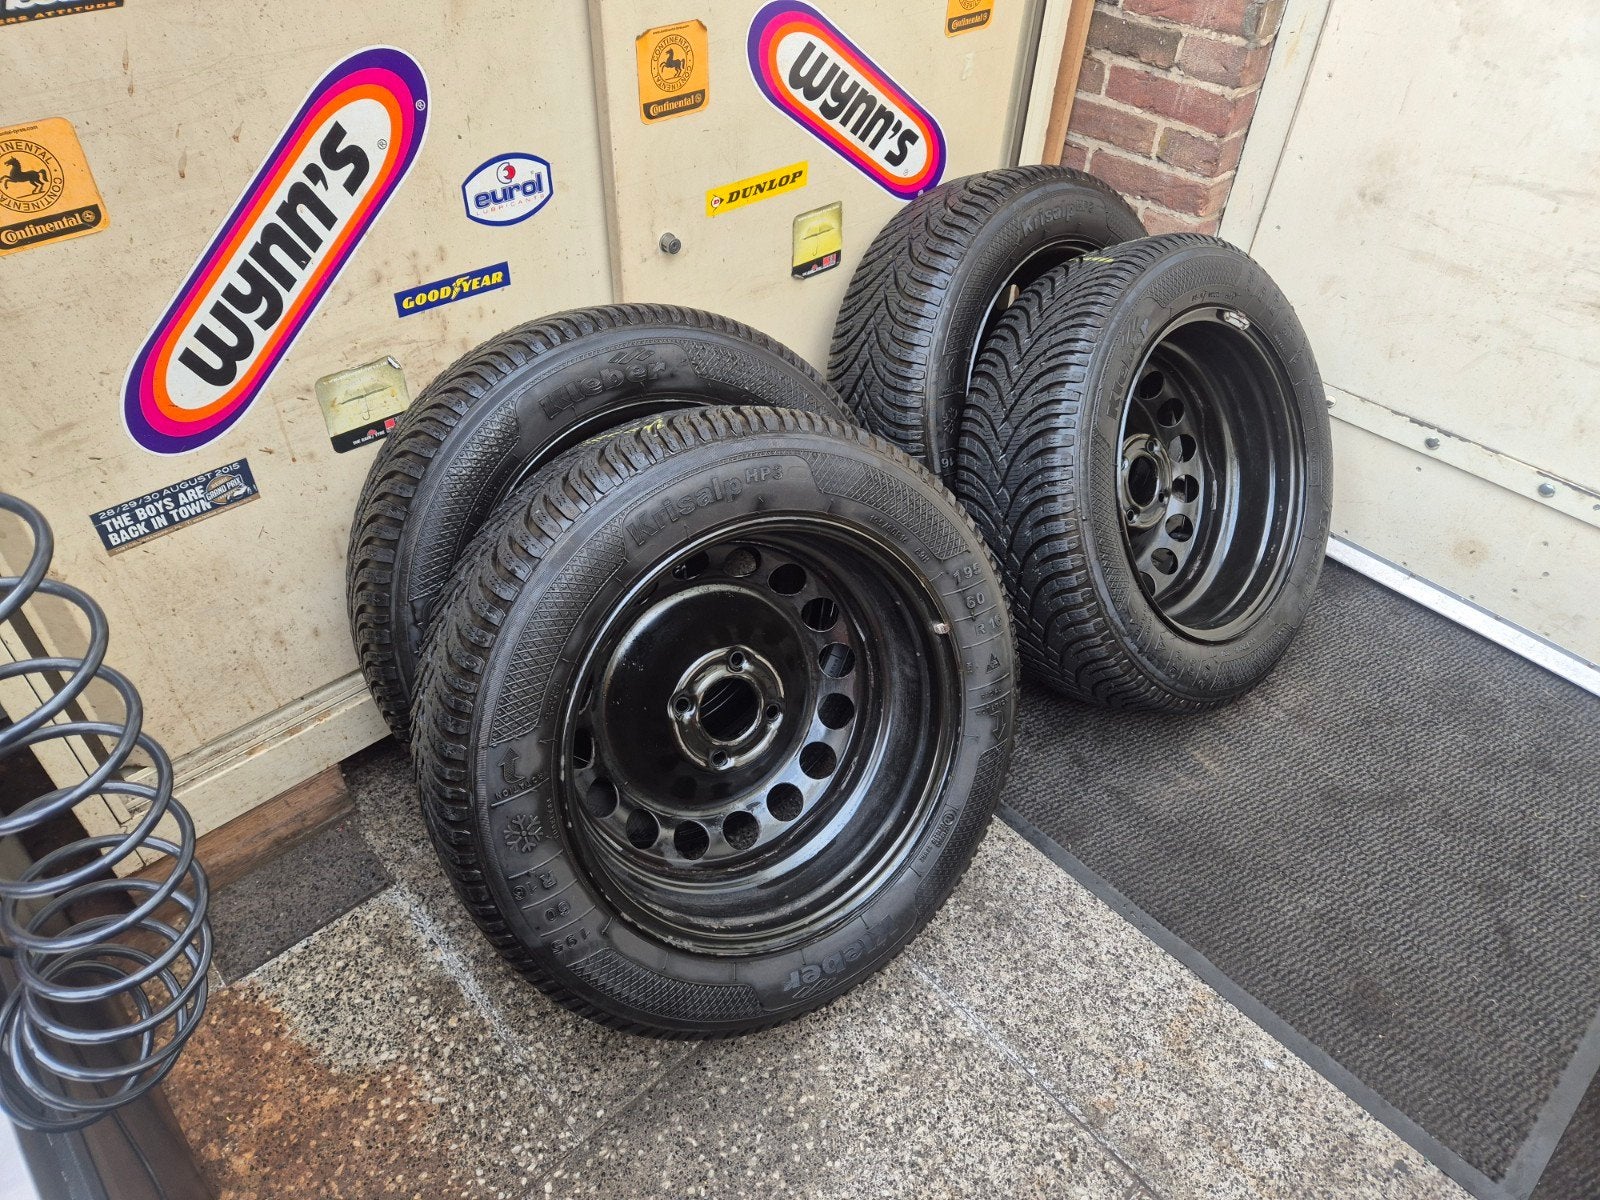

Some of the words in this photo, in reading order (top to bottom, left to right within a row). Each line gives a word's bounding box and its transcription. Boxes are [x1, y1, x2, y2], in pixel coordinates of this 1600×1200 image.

[35, 1, 117, 19] ATTITUDE
[652, 35, 692, 62] CONTINENTAL
[650, 95, 694, 117] Continental
[474, 171, 544, 209] eurol
[726, 169, 803, 204] DUNLOP
[0, 213, 83, 245] Continental
[402, 271, 504, 309] GOODYEAR
[98, 492, 160, 519] 28/29/30
[162, 473, 213, 496] AUGUST
[214, 462, 240, 477] 2015
[625, 476, 743, 547] Krisalp
[745, 464, 784, 484] HP3
[101, 512, 134, 533] THE
[134, 497, 174, 521] BOYS
[178, 485, 206, 506] ARE
[107, 524, 150, 547] BACK
[151, 513, 168, 530] IN
[169, 499, 213, 523] TOWN
[953, 562, 980, 585] 195
[966, 592, 985, 609] 60
